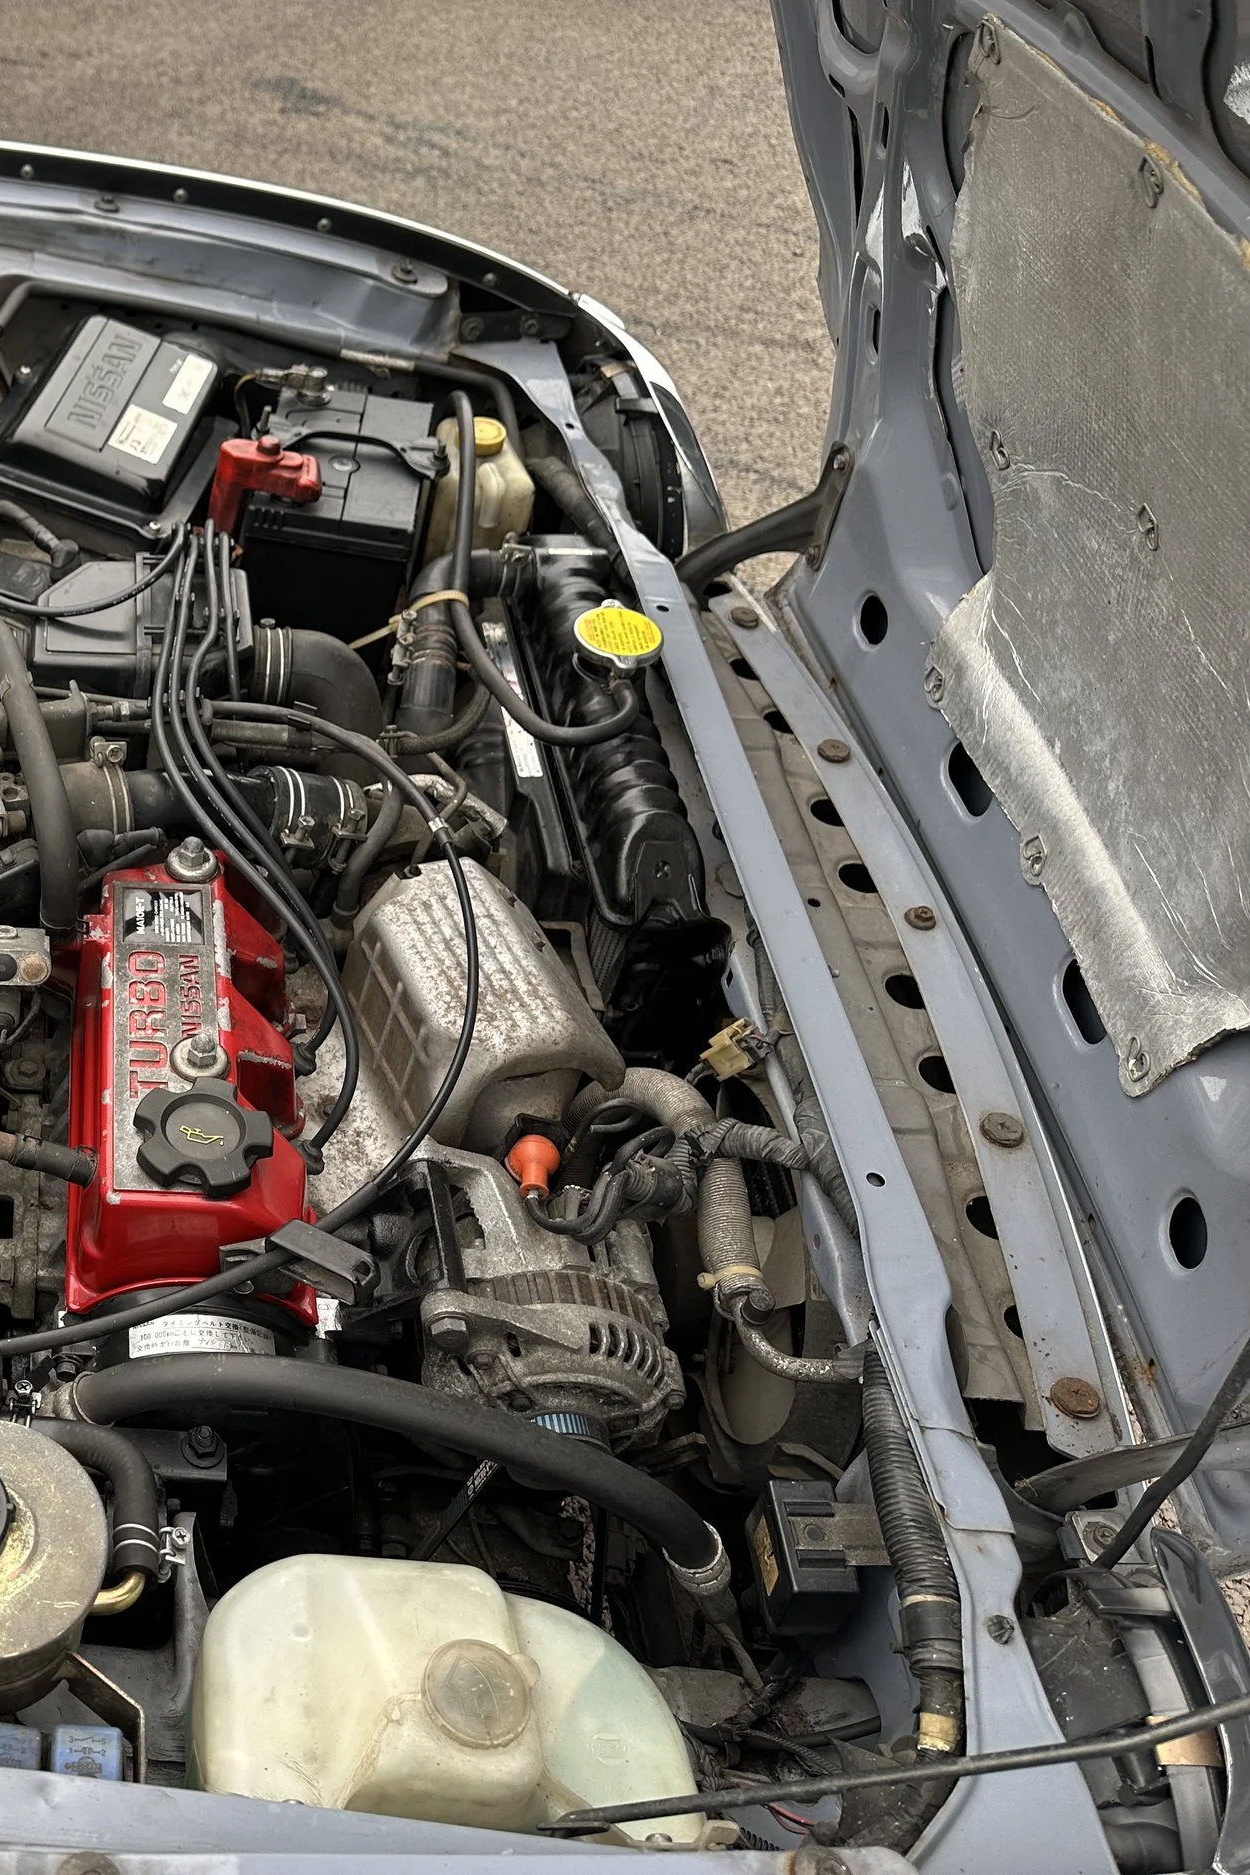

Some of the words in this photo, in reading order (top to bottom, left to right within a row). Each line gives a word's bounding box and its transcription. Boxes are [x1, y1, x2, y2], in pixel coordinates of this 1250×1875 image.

[67, 333, 142, 430] NISSAN
[135, 897, 146, 935] MA10E-T
[128, 951, 168, 1098] TURBO
[179, 954, 202, 1038] NISSAN
